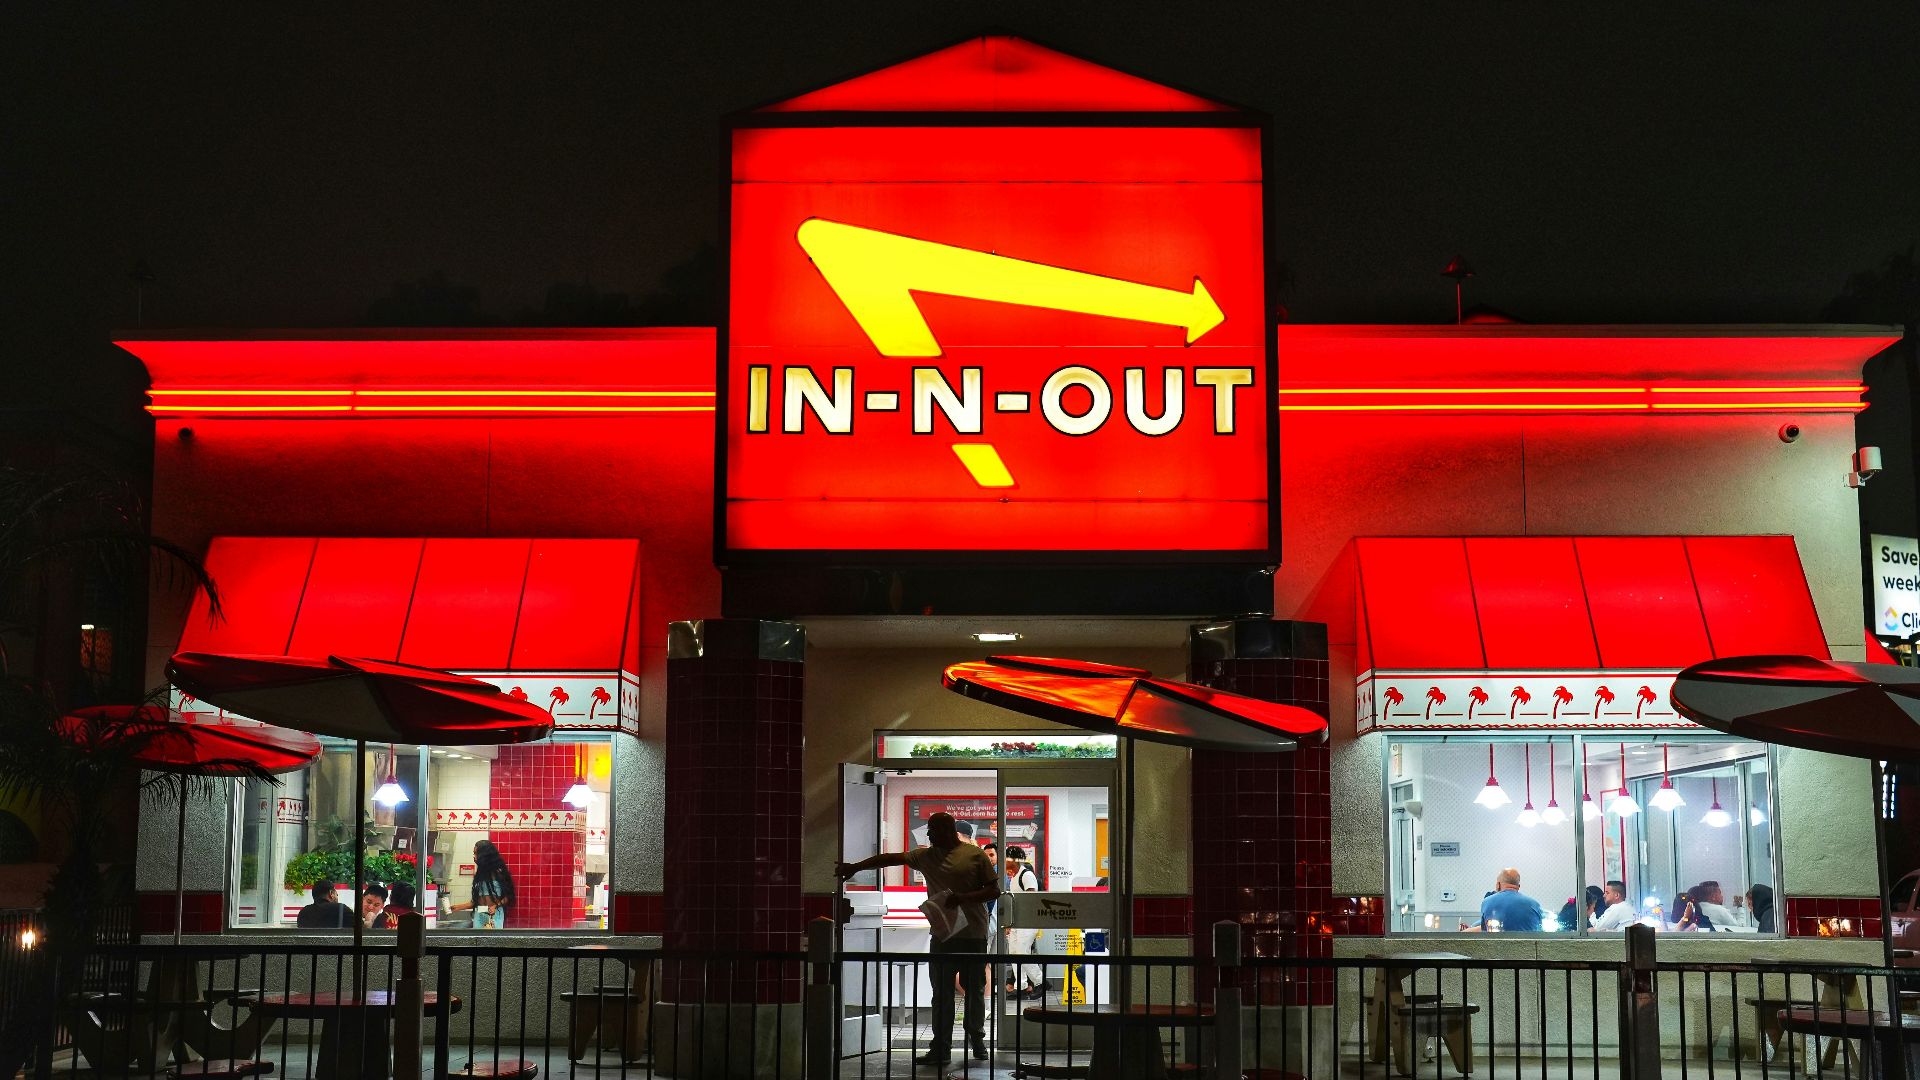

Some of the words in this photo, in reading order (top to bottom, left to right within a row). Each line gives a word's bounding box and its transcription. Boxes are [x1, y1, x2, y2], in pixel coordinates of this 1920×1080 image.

[747, 365, 1255, 435] IN-N-OUT
[1881, 545, 1918, 566] Save
[1901, 612, 1920, 629] Cli
